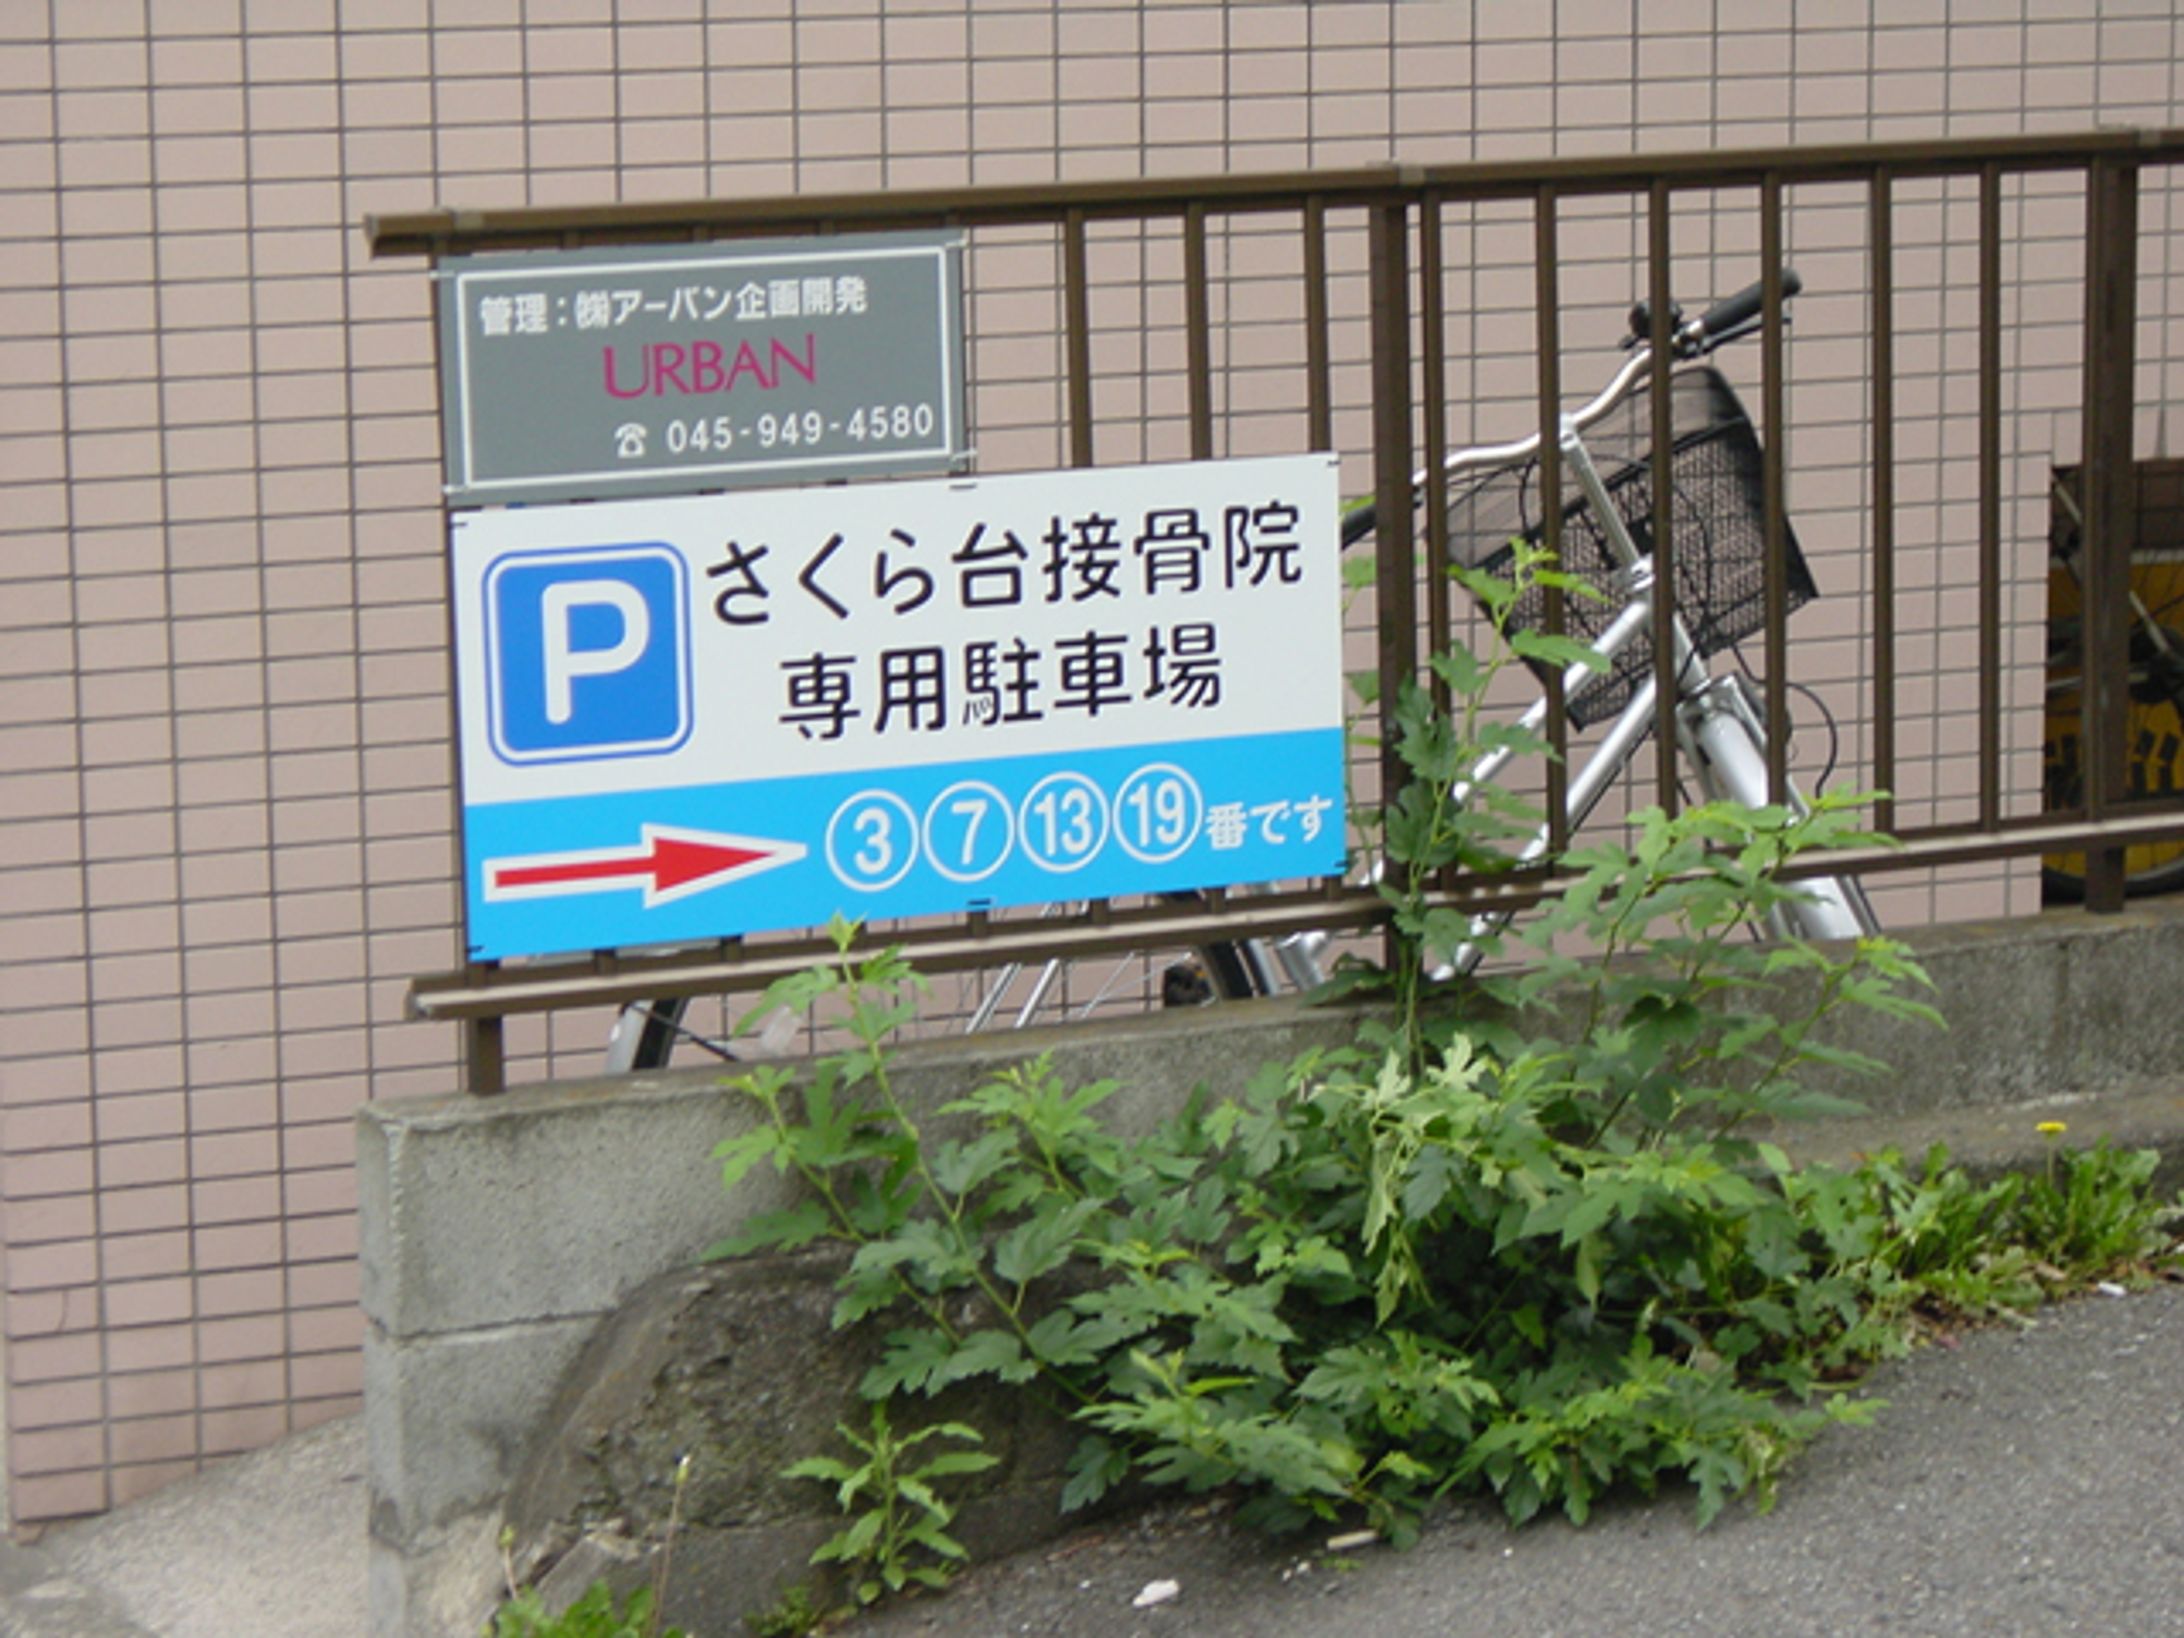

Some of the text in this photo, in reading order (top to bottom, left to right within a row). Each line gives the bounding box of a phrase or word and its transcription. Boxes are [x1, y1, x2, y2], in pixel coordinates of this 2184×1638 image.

[602, 332, 816, 398] URBAN
[666, 402, 934, 454] 045-949-4580
[706, 500, 1304, 626] さくら台接骨院
[540, 578, 650, 726] P
[778, 624, 1224, 740] 専用駐車場
